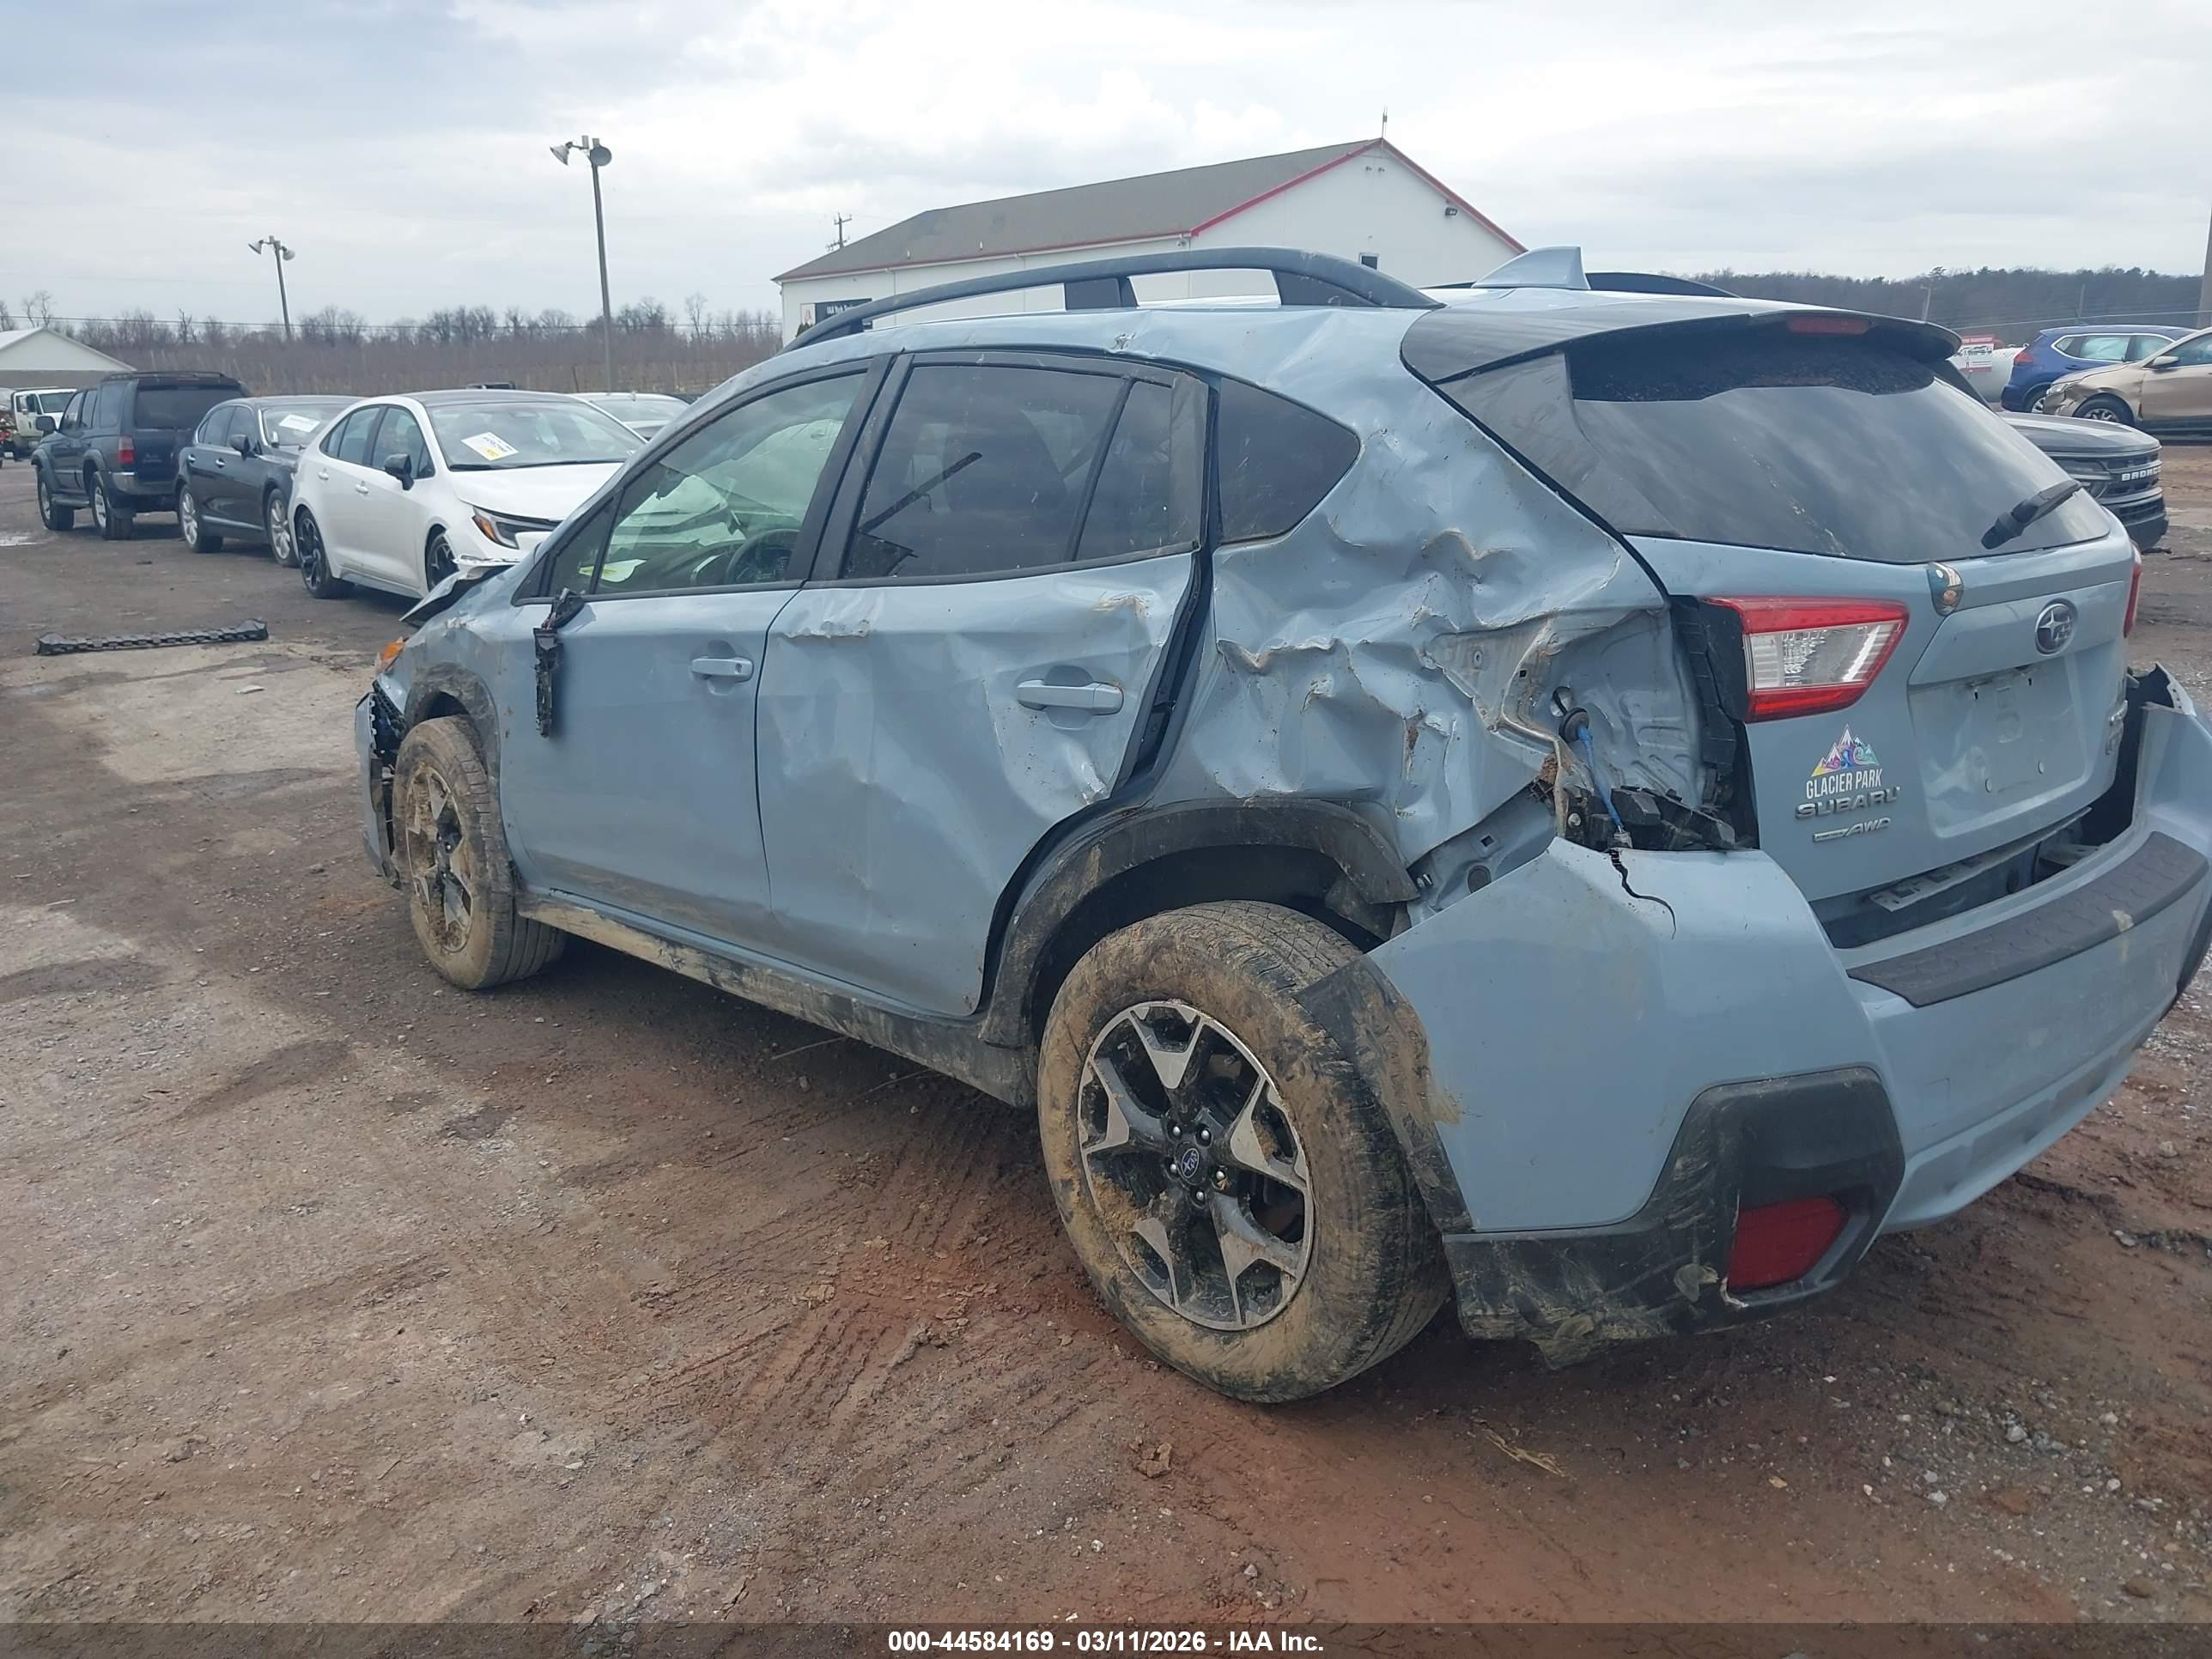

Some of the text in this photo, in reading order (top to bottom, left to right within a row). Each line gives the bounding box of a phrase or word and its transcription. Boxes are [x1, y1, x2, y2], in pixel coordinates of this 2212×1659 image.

[1806, 768, 1883, 799] GLACIER PARK
[1795, 786, 1902, 819] SUBARU
[1844, 817, 1892, 837] AWD
